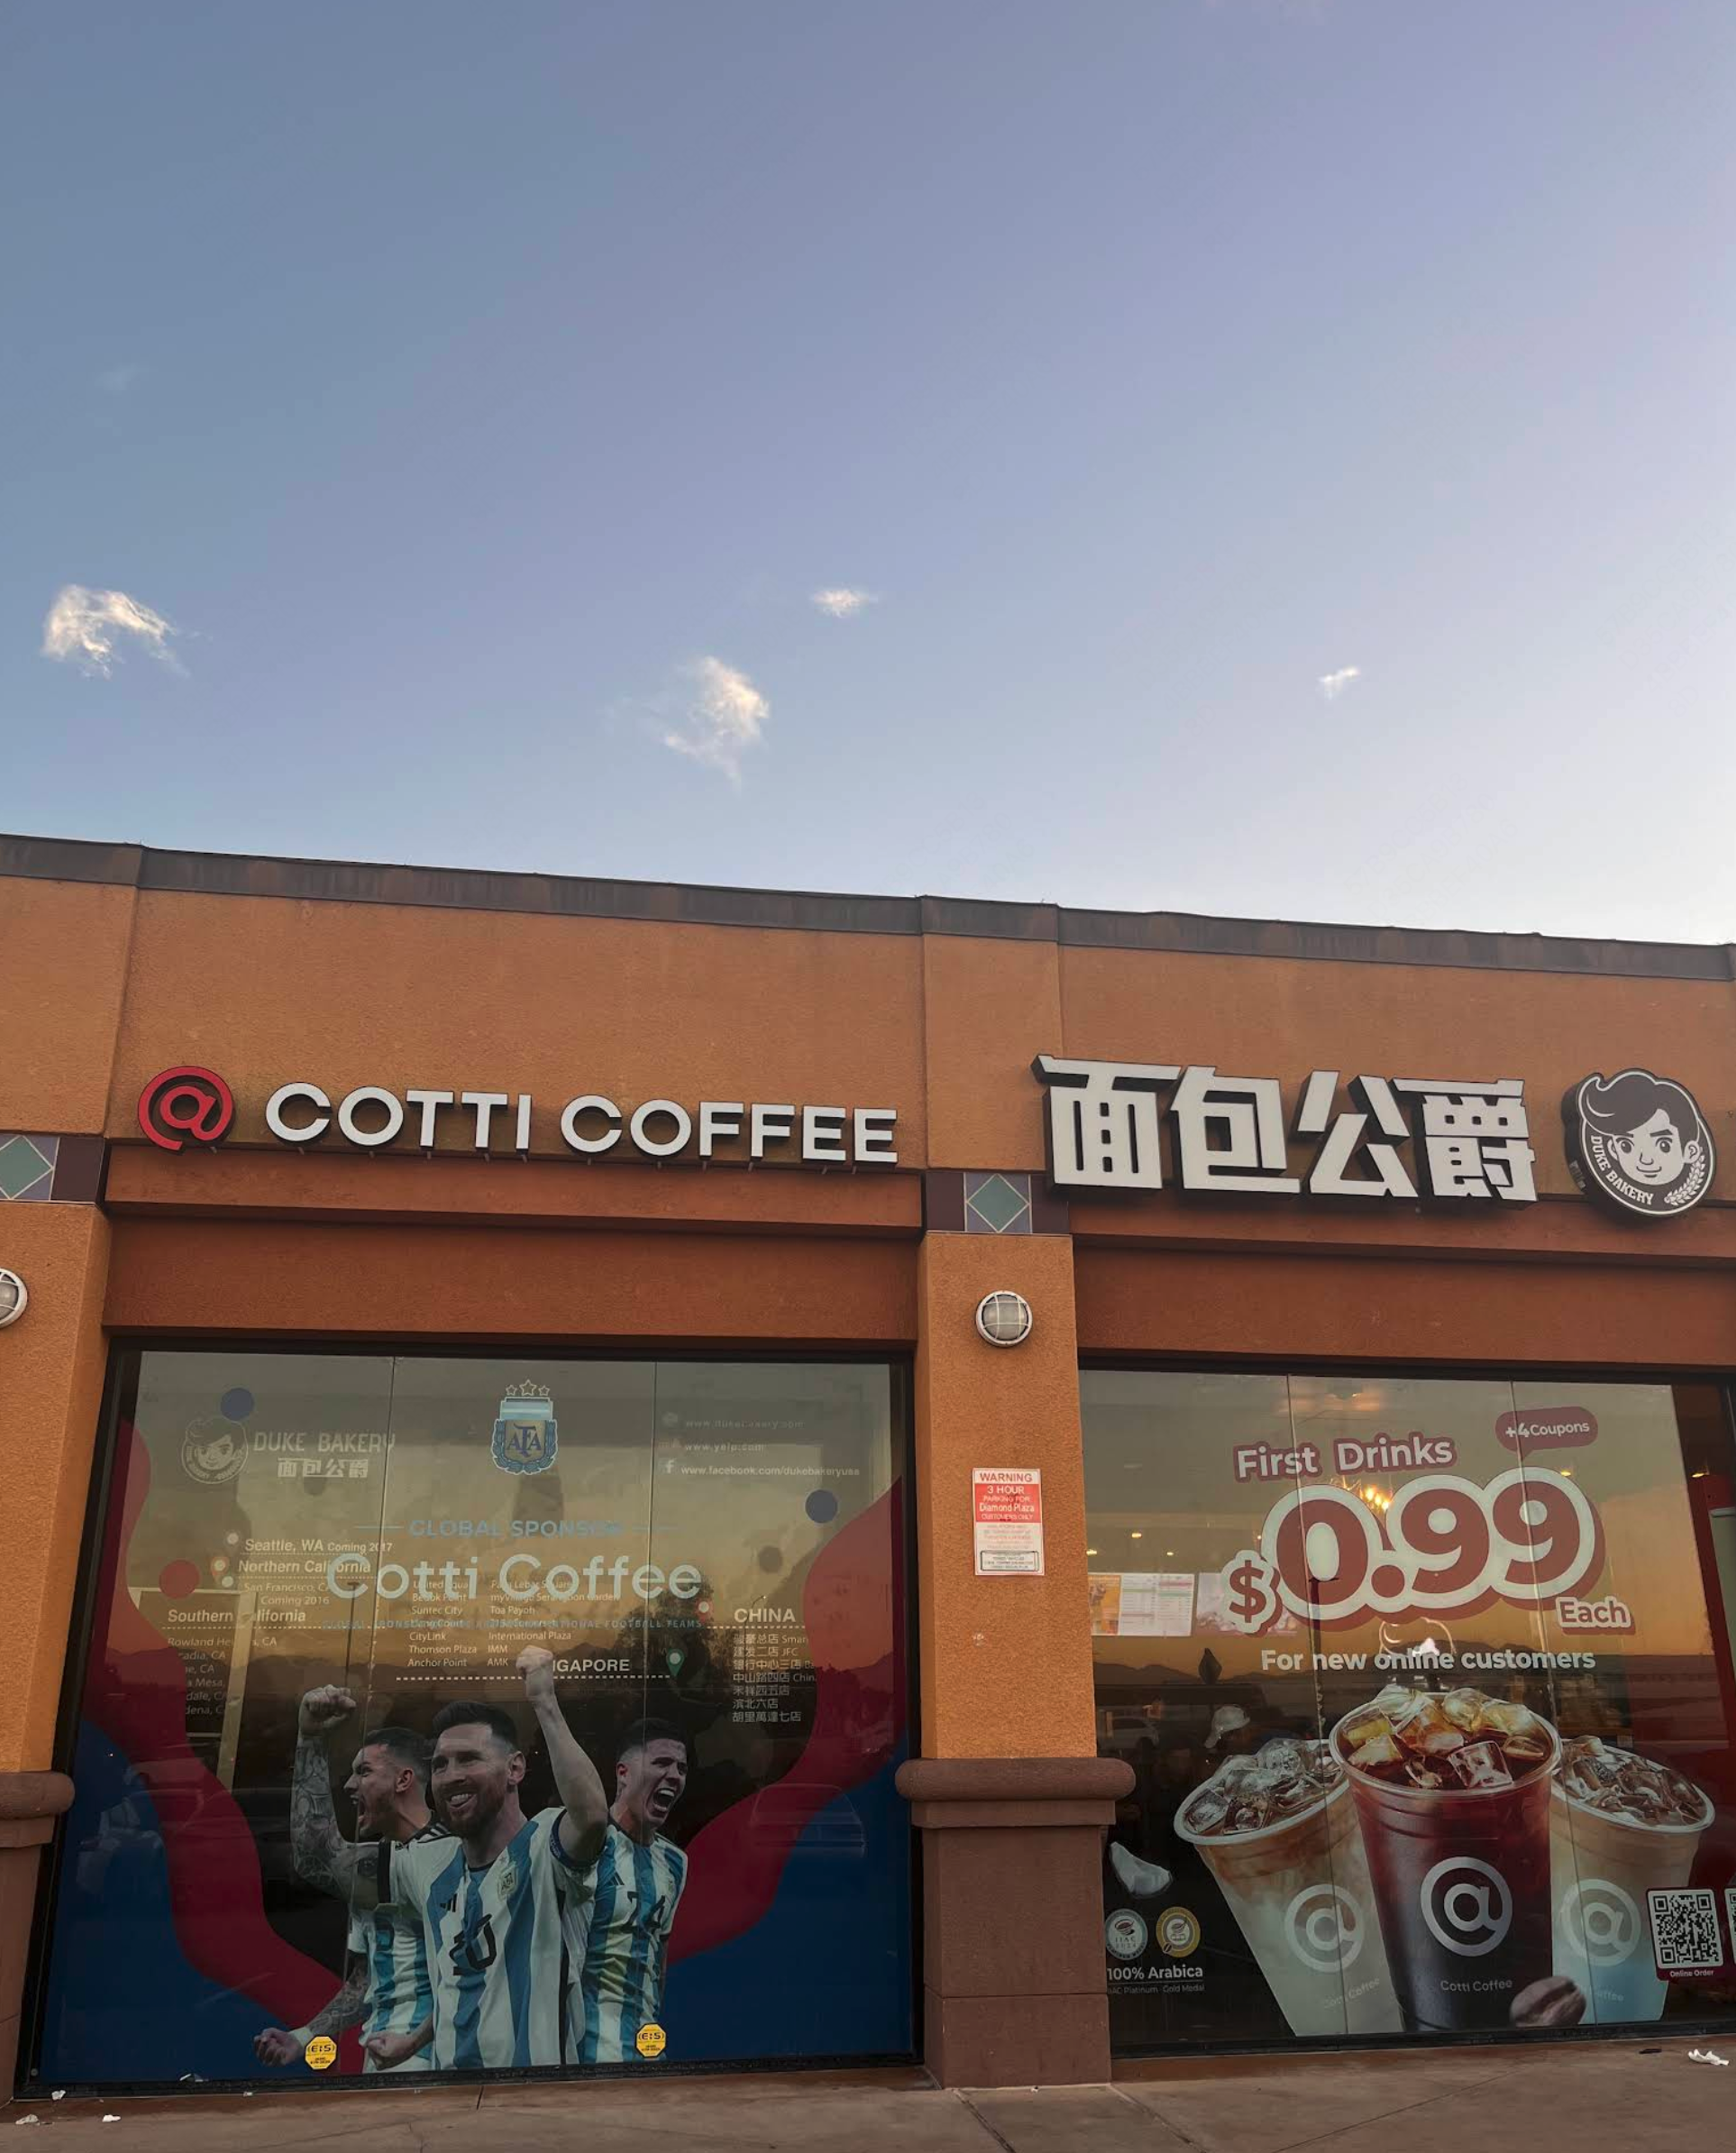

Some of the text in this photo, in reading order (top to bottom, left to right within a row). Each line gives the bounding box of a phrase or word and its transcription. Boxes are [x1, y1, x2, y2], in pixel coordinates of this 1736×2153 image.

[265, 1082, 532, 1150] COTTI
[560, 1095, 898, 1164] COFFEE
[1033, 1055, 1538, 1203] 面包公爵
[1590, 1135, 1654, 1205] DUKE BAKERY
[253, 1432, 396, 1452] DUKE BAKERY
[1237, 1435, 1454, 1479] First Drinks
[277, 1457, 368, 1479] 面包公爵
[980, 1472, 1033, 1483] WARNING
[997, 1486, 1025, 1494] HOUR
[1016, 1495, 1031, 1503] FOR
[979, 1502, 1035, 1513] Diamond Plaza
[1019, 1513, 1034, 1521] ONLY
[409, 1520, 502, 1538] GLOBAL
[245, 1538, 297, 1553] Seattle,
[301, 1539, 324, 1552] WA
[327, 1543, 367, 1556] Coming
[238, 1559, 301, 1572] Northern
[327, 1553, 702, 1600] Cotti Coffee
[243, 1582, 262, 1592] San
[264, 1582, 315, 1594] Francisco,
[260, 1595, 330, 1607] Coming 2016
[168, 1609, 233, 1623] Southern
[411, 1605, 462, 1617] Suntec City
[490, 1606, 535, 1617] Toa Payoh
[734, 1608, 796, 1623] CHINA
[1559, 1598, 1631, 1627] Each
[168, 1637, 215, 1647] Rowland
[261, 1636, 278, 1647] CA
[409, 1632, 447, 1644] CityLink
[489, 1631, 571, 1640] International Plaza
[408, 1645, 477, 1654] Thomson Plaza
[488, 1645, 508, 1654] IMM
[781, 1647, 799, 1658] JFC
[211, 1651, 226, 1661] CA
[407, 1657, 467, 1667] Anchor Point
[487, 1657, 509, 1667] AMK
[1262, 1648, 1596, 1672] For new online customers
[200, 1664, 215, 1674] CA
[1107, 1964, 1203, 1981] 100% Arabica
[1670, 1968, 1714, 1978] Online Order
[1162, 1984, 1180, 1993] Gold
[1182, 1983, 1205, 1993] Medal
[1439, 1979, 1513, 1993] Cotti Coffee
